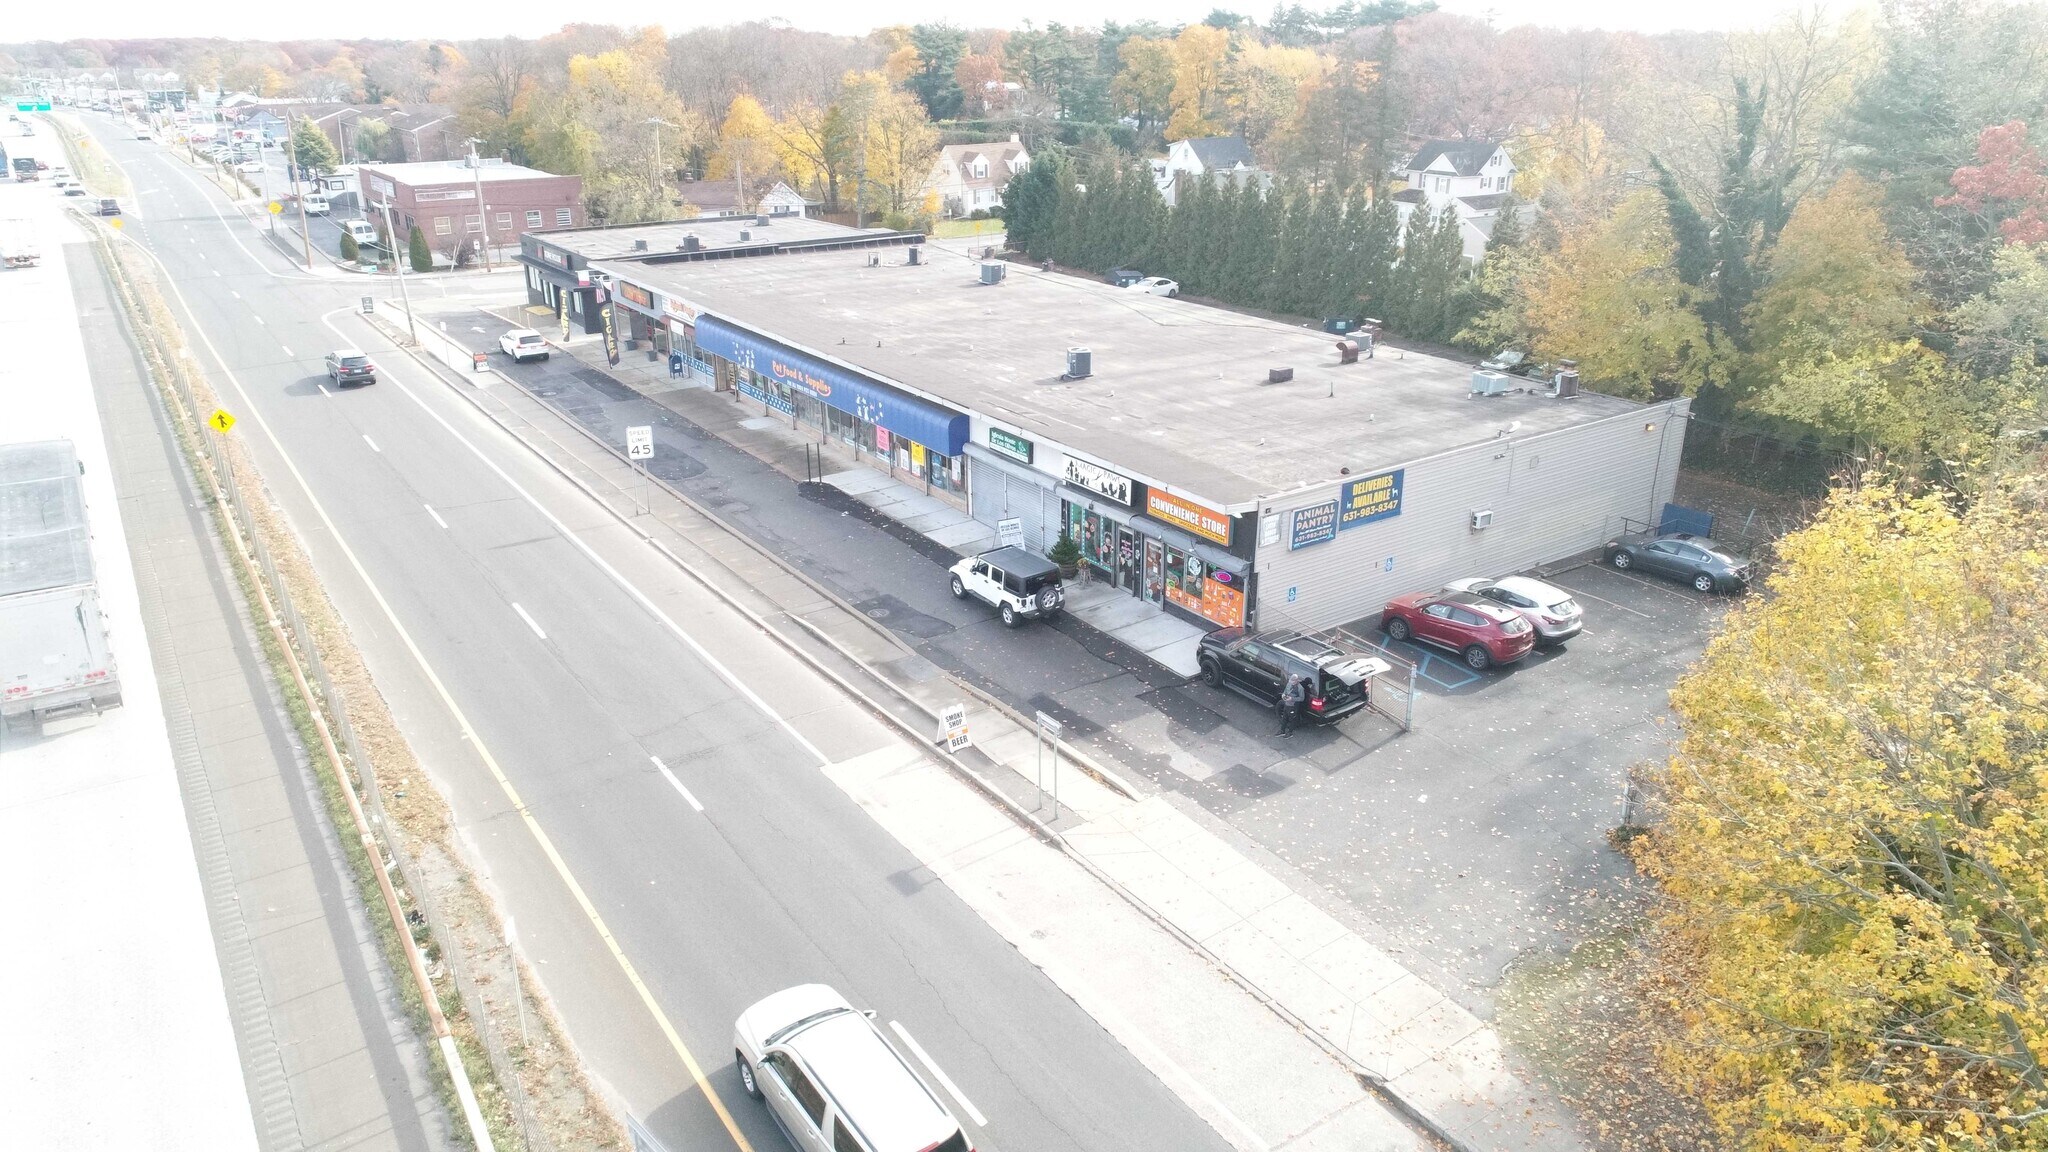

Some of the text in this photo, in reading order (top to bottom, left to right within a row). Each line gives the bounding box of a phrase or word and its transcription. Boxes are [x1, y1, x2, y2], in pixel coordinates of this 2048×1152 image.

[601, 308, 617, 357] CIGARS
[772, 360, 783, 373] Pet
[783, 364, 797, 380] Food
[805, 374, 831, 395] Supplies
[631, 444, 651, 455] 45
[1075, 459, 1097, 475] MAGIC
[1353, 475, 1393, 496] DELIVERIES
[1172, 498, 1182, 506] ALL
[1192, 505, 1203, 514] ONE
[1352, 489, 1391, 509] AVAILABLE
[1150, 496, 1226, 537] CONVENIENCE STORE
[1296, 504, 1336, 521] ANIMAL
[1343, 500, 1399, 522] 631-983-8347
[1296, 513, 1335, 531] PANTRY
[945, 711, 964, 722] SMOKE
[948, 719, 963, 729] SHOP
[951, 735, 968, 747] BEER
